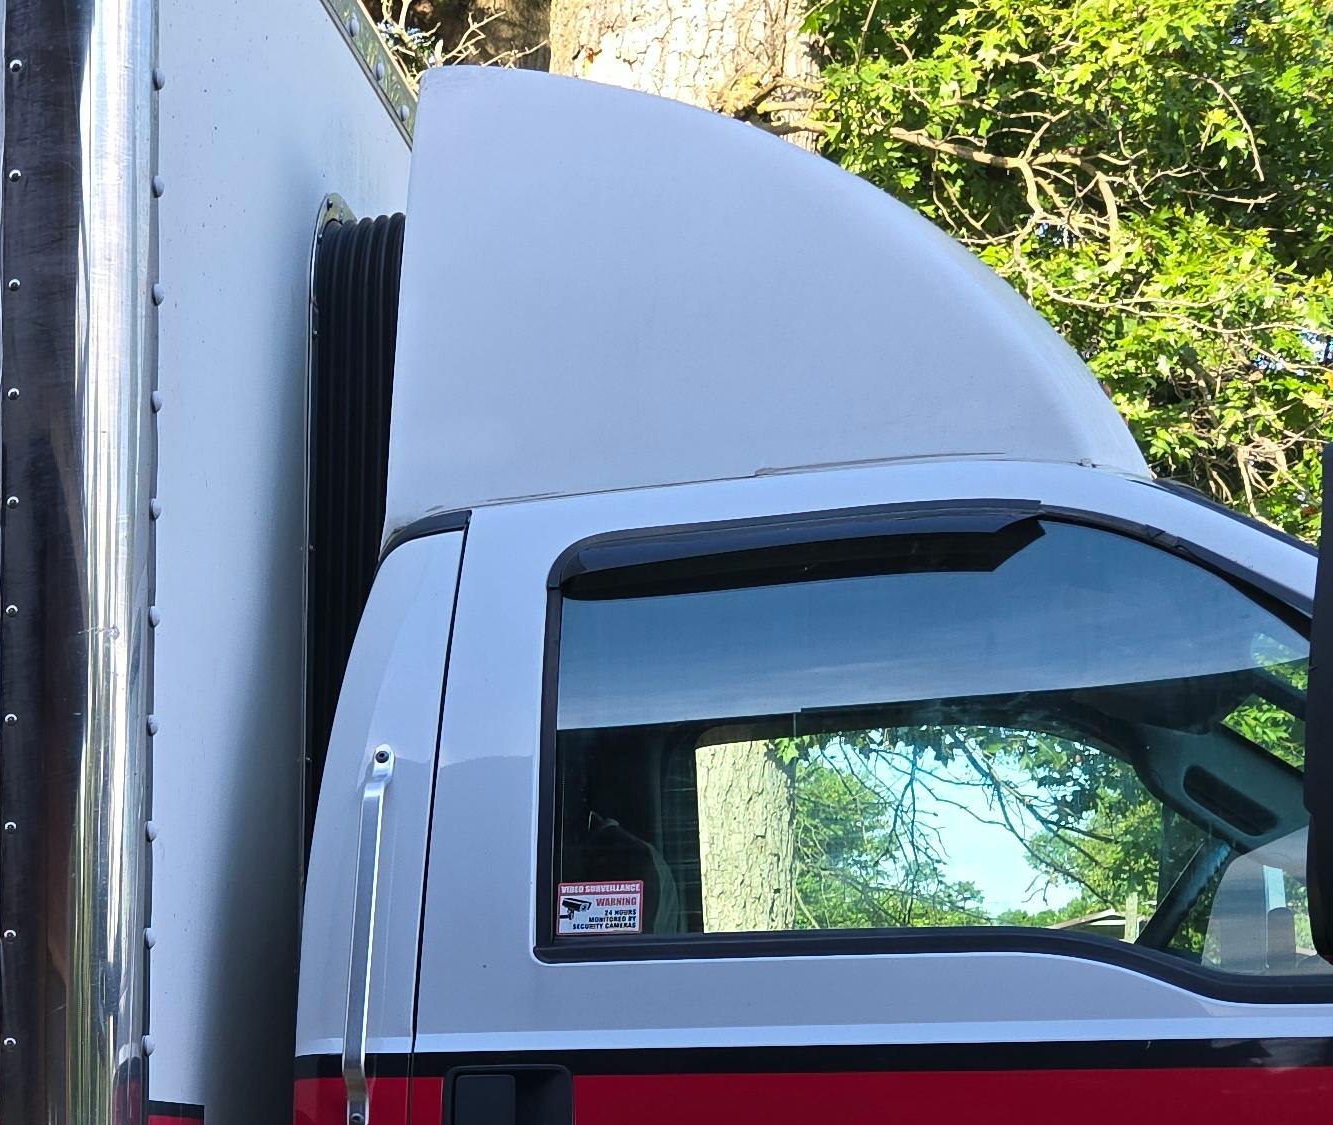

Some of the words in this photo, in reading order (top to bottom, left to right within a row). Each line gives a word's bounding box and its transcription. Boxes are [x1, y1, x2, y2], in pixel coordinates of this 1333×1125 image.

[561, 885, 584, 894] VIDEO
[584, 883, 641, 893] SURVEILLANCE
[596, 897, 637, 907] WARNING
